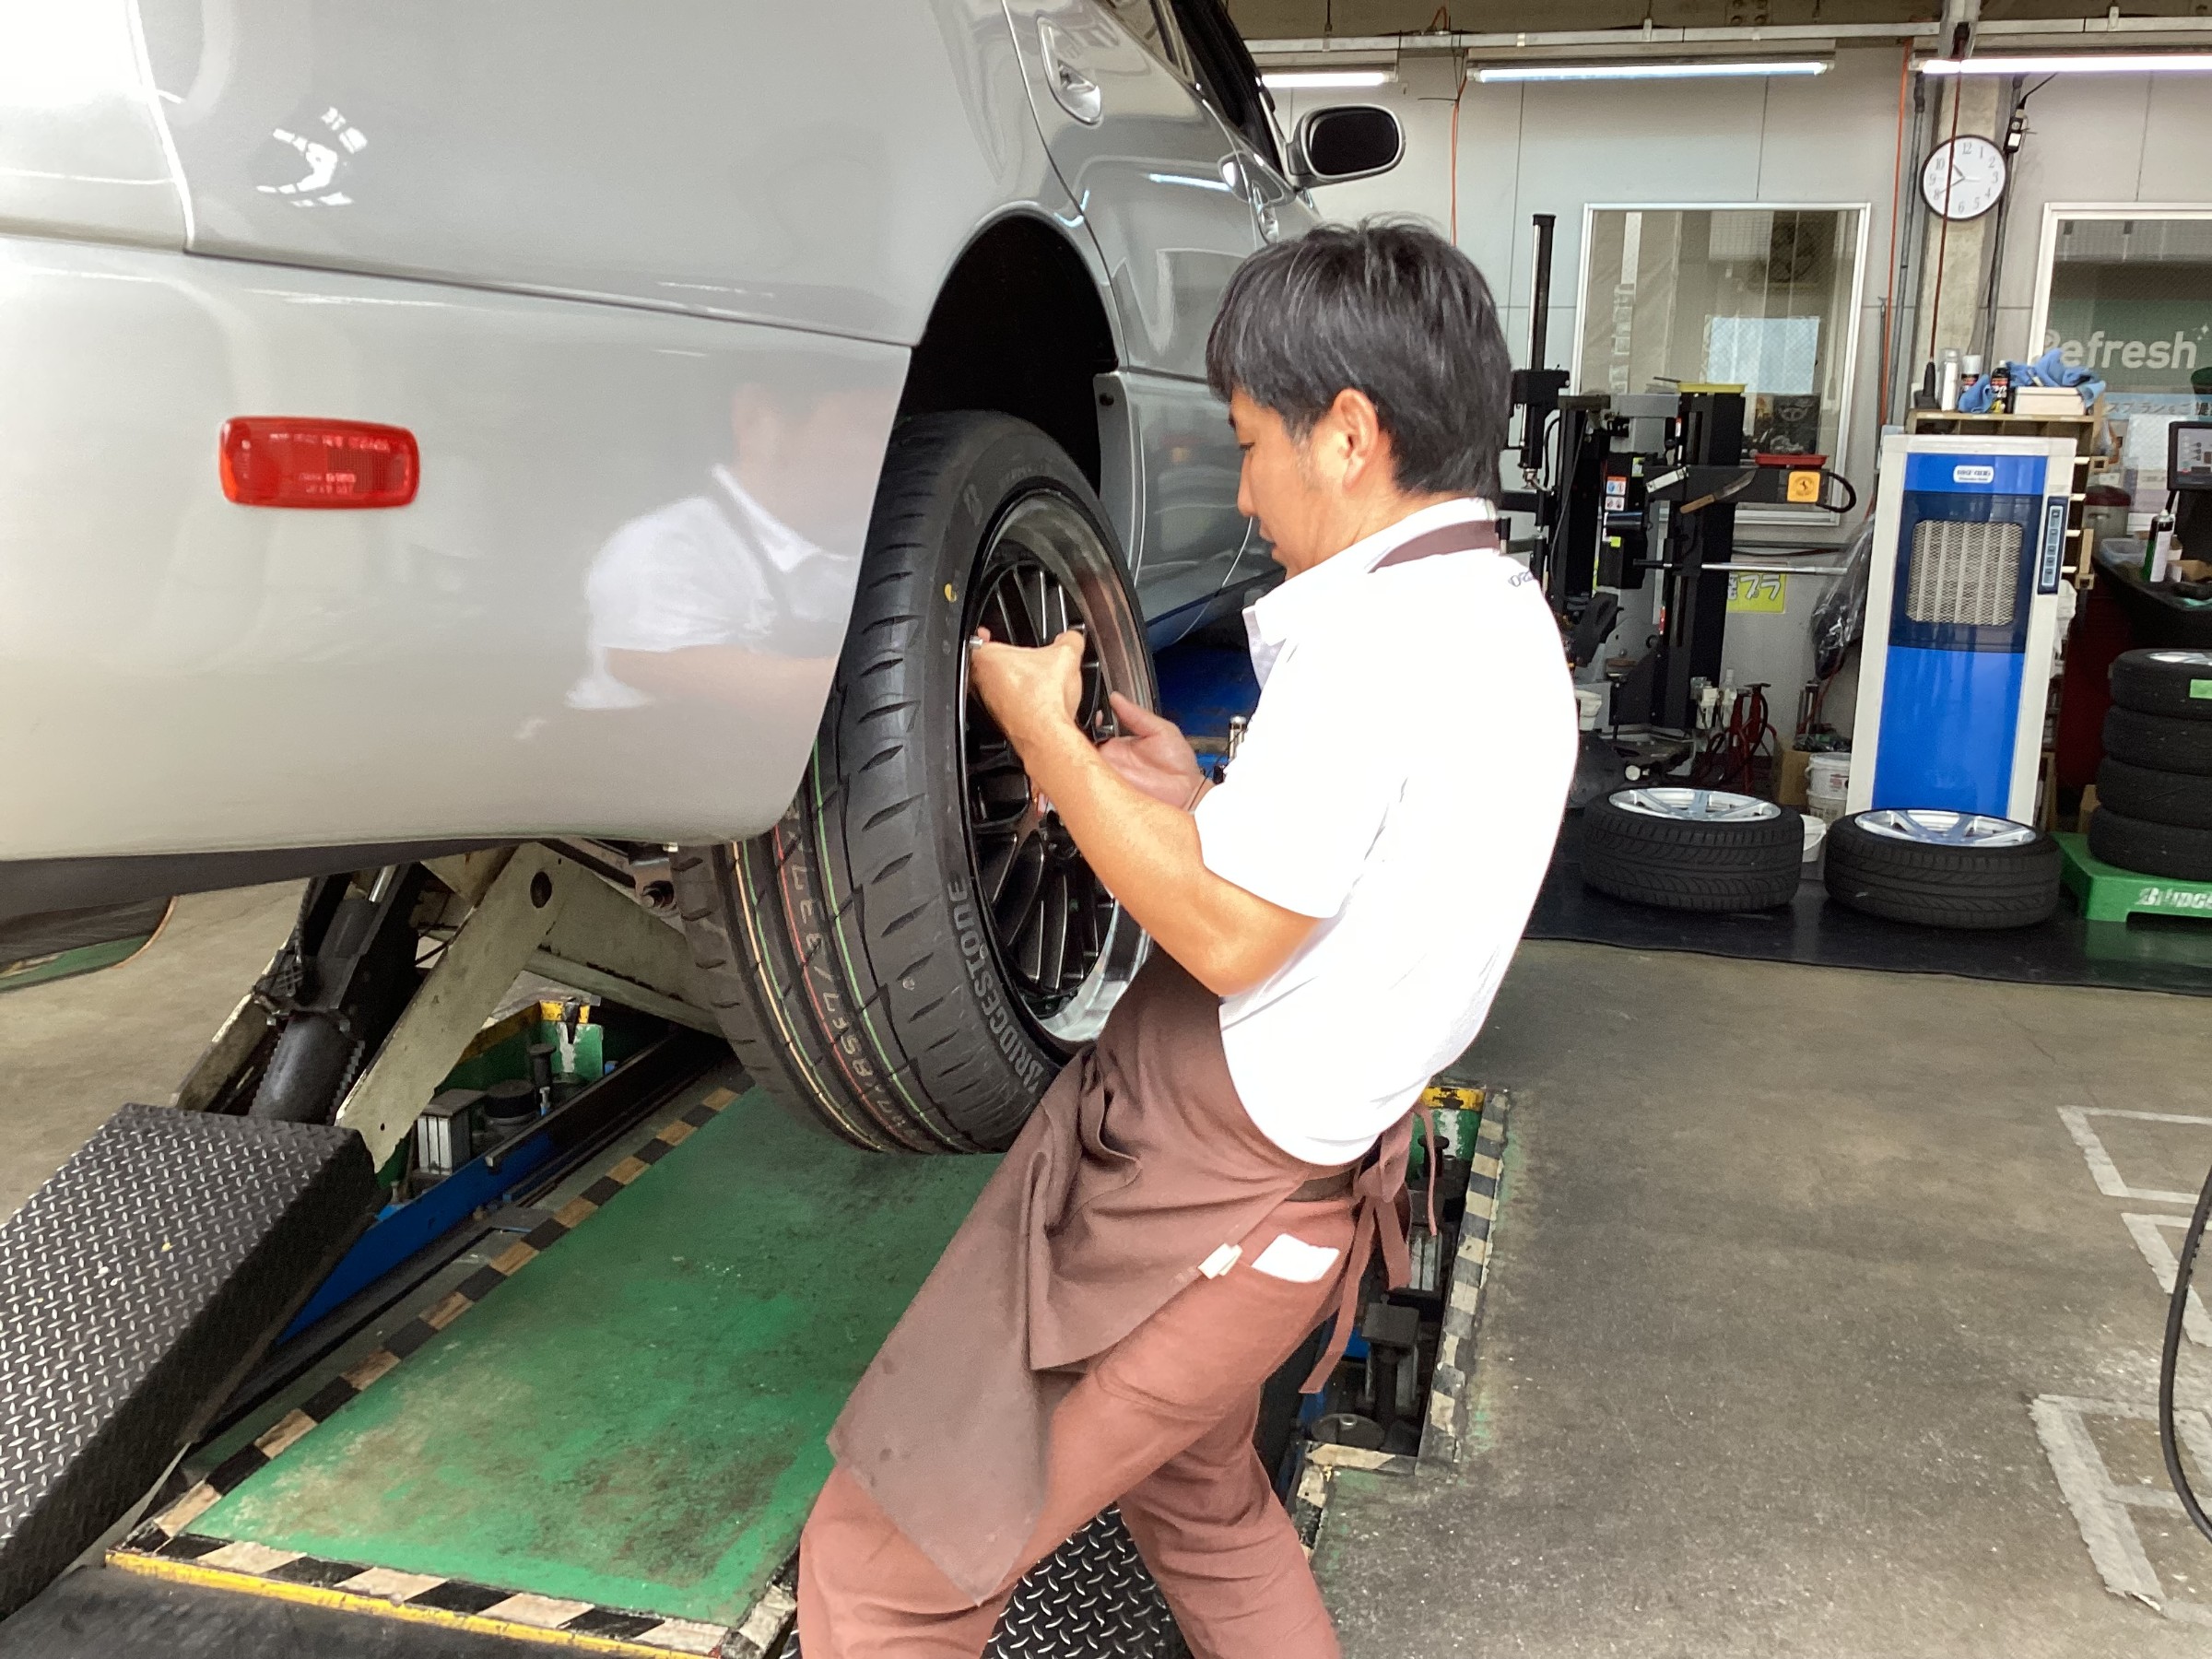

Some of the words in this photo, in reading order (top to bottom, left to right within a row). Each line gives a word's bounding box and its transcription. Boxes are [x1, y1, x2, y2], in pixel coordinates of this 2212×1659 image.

[1962, 142, 1972, 155] 12
[1936, 158, 1946, 171] 10
[1988, 156, 1995, 168] 2
[1929, 173, 1936, 185] 9
[1992, 171, 1998, 183] 3
[1984, 187, 1991, 198] 4
[1958, 201, 1965, 214] 6
[1973, 196, 1980, 209] 5
[947, 873, 1044, 1094] BRIDGESTONE
